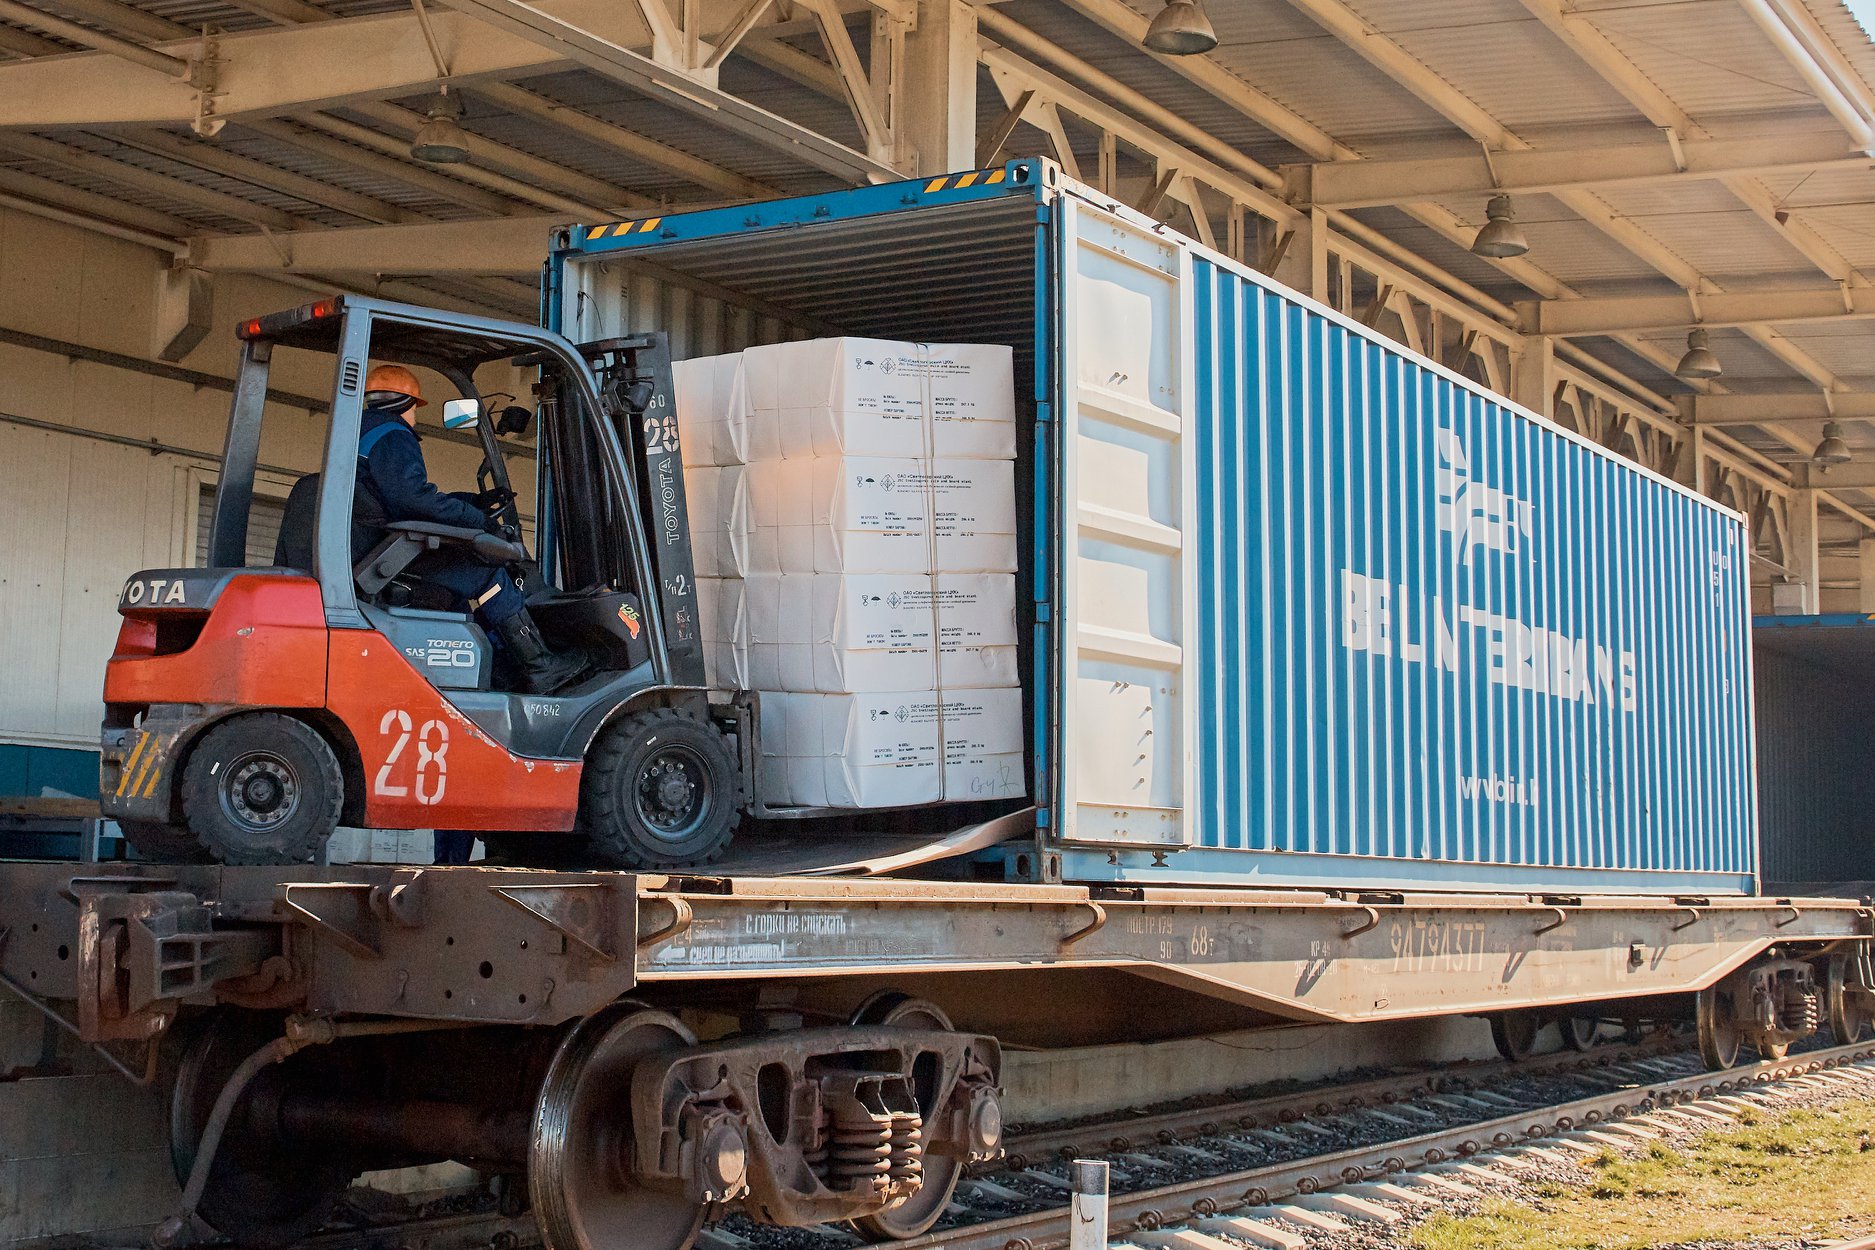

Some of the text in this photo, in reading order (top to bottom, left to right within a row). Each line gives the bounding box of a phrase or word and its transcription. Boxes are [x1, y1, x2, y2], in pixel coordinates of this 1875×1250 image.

[644, 416, 680, 456] 28
[658, 457, 680, 545] TOYOTA
[406, 648, 475, 668] SAS 20
[374, 709, 450, 806] 28
[754, 914, 785, 940] горки
[787, 914, 800, 934] не
[801, 914, 846, 938] спускать
[1160, 940, 1172, 959] 90
